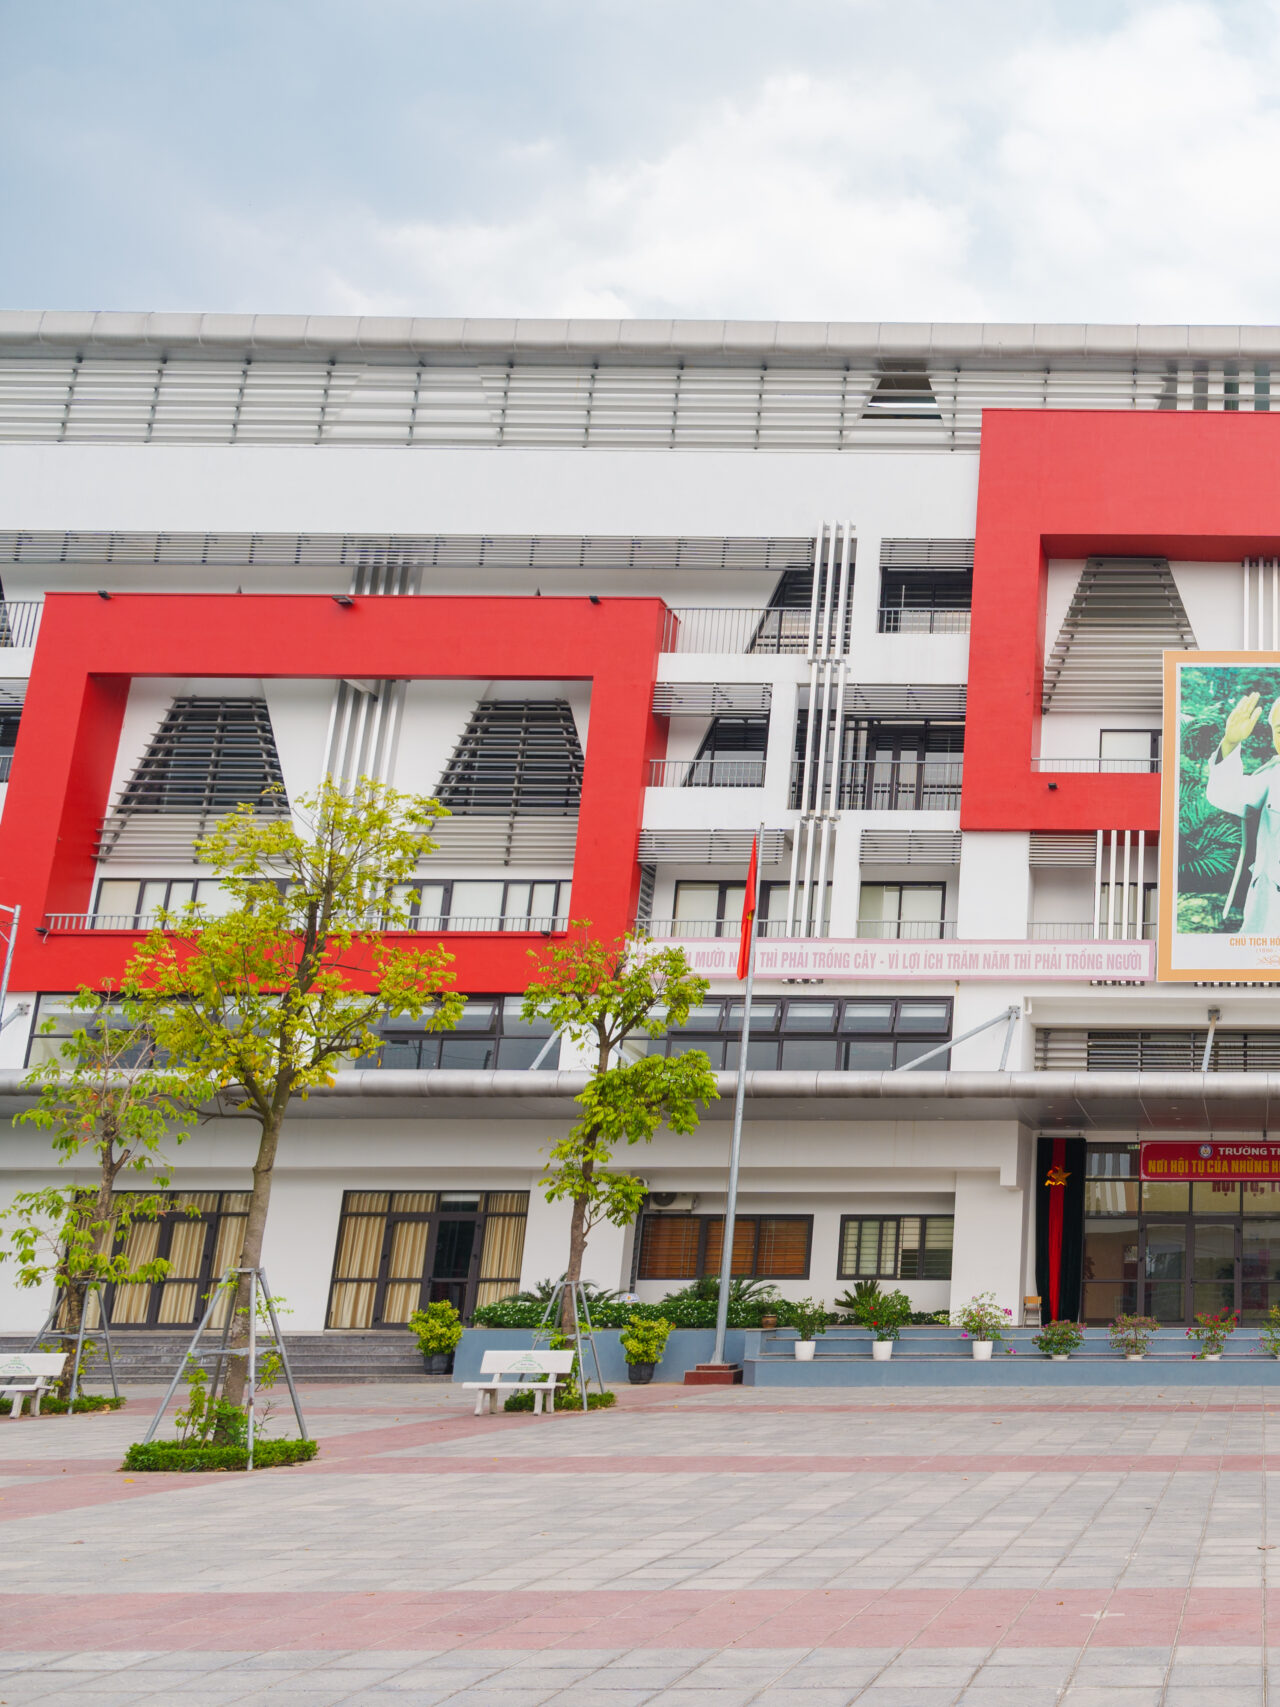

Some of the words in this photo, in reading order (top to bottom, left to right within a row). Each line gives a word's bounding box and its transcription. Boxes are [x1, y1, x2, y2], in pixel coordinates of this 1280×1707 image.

[694, 946, 725, 968] MƯỜI
[760, 949, 778, 969] THÌ
[780, 945, 809, 969] PHẢI
[854, 949, 877, 969] CÂY
[888, 950, 900, 969] VÌ
[902, 951, 920, 973] LỢI
[924, 950, 944, 970] ÍCH
[947, 949, 979, 970] TRĂM
[983, 949, 1010, 970] NĂM
[1014, 949, 1032, 970] THÌ
[1035, 946, 1062, 970] PHẢI
[1106, 949, 1143, 971] NGƯỜI
[1218, 1145, 1268, 1156] TRƯỜNG
[1148, 1158, 1168, 1174] NƠI
[1170, 1157, 1189, 1177] HỘI
[1192, 1159, 1205, 1177] TỤ
[1206, 1156, 1229, 1174] CỦA
